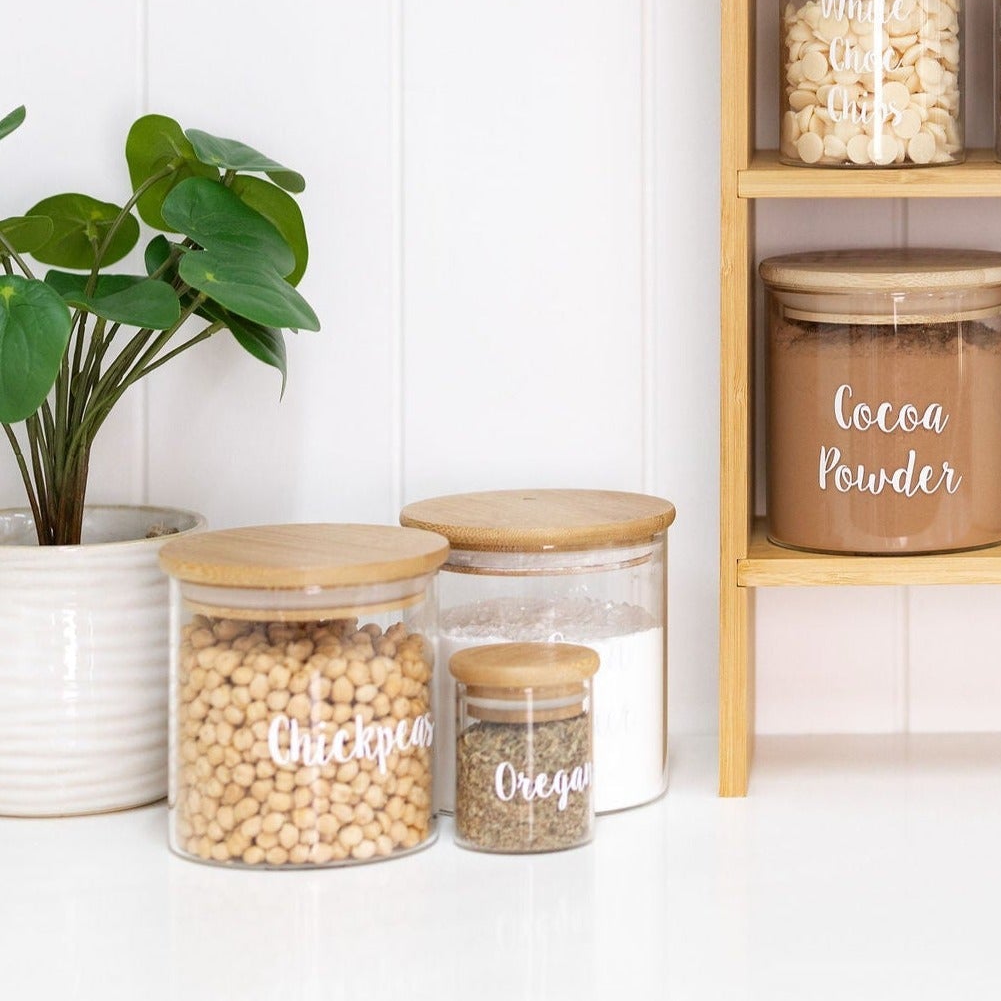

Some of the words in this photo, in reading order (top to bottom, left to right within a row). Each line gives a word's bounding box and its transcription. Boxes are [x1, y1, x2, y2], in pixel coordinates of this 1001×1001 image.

[829, 37, 903, 74] Choc
[834, 384, 949, 434] Cocoa
[819, 445, 963, 498] Powder
[268, 714, 435, 775] Chickpeas
